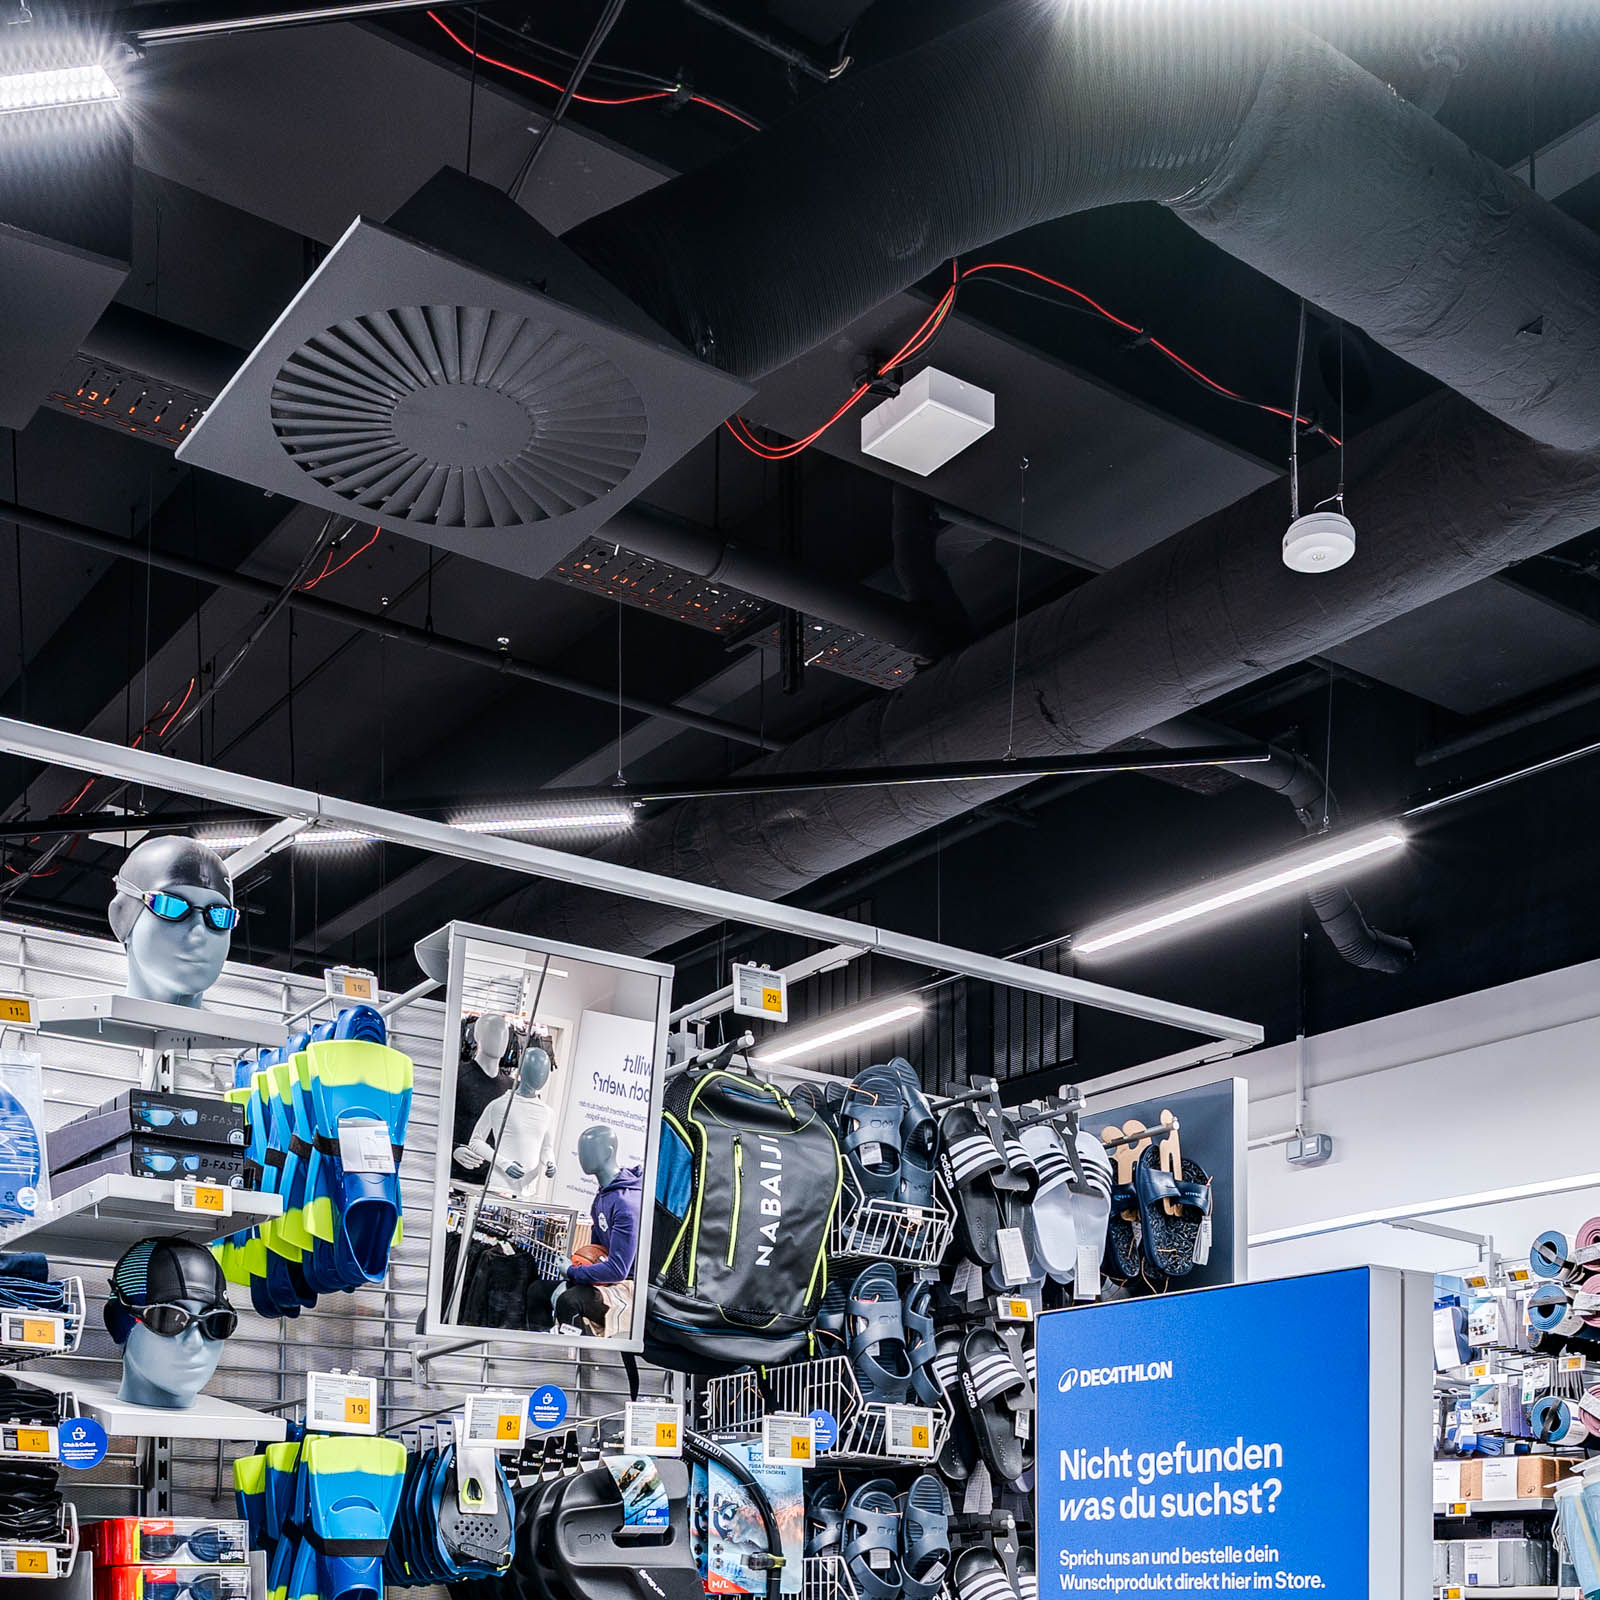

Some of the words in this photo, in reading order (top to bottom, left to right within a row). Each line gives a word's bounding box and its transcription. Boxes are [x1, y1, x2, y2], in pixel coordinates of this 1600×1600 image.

[201, 1115, 241, 1128] B-FAST
[201, 1160, 241, 1172] B-FAST
[940, 1153, 954, 1190] adidas
[755, 1134, 782, 1267] NABAIJI
[1080, 1361, 1173, 1388] DECATHLON
[962, 1372, 978, 1409] adidas
[693, 1440, 724, 1459] NABAIJI
[1059, 1446, 1132, 1481] Nicht
[1137, 1437, 1283, 1484] gefunden
[1059, 1497, 1115, 1521] was
[1120, 1487, 1156, 1520] du
[1161, 1478, 1283, 1519] suchst?
[1059, 1549, 1103, 1569] Sprich
[1105, 1552, 1130, 1565] uns
[1132, 1552, 1149, 1564] an
[1152, 1548, 1180, 1564] und
[1182, 1546, 1242, 1563] bestelle
[1244, 1545, 1279, 1562] dein
[712, 1581, 729, 1590] M/L
[1059, 1574, 1172, 1593] Wunschprodukt
[1174, 1573, 1220, 1590] direkt
[1221, 1572, 1251, 1589] hier
[1253, 1572, 1273, 1588] im
[1275, 1570, 1326, 1588] Store.
